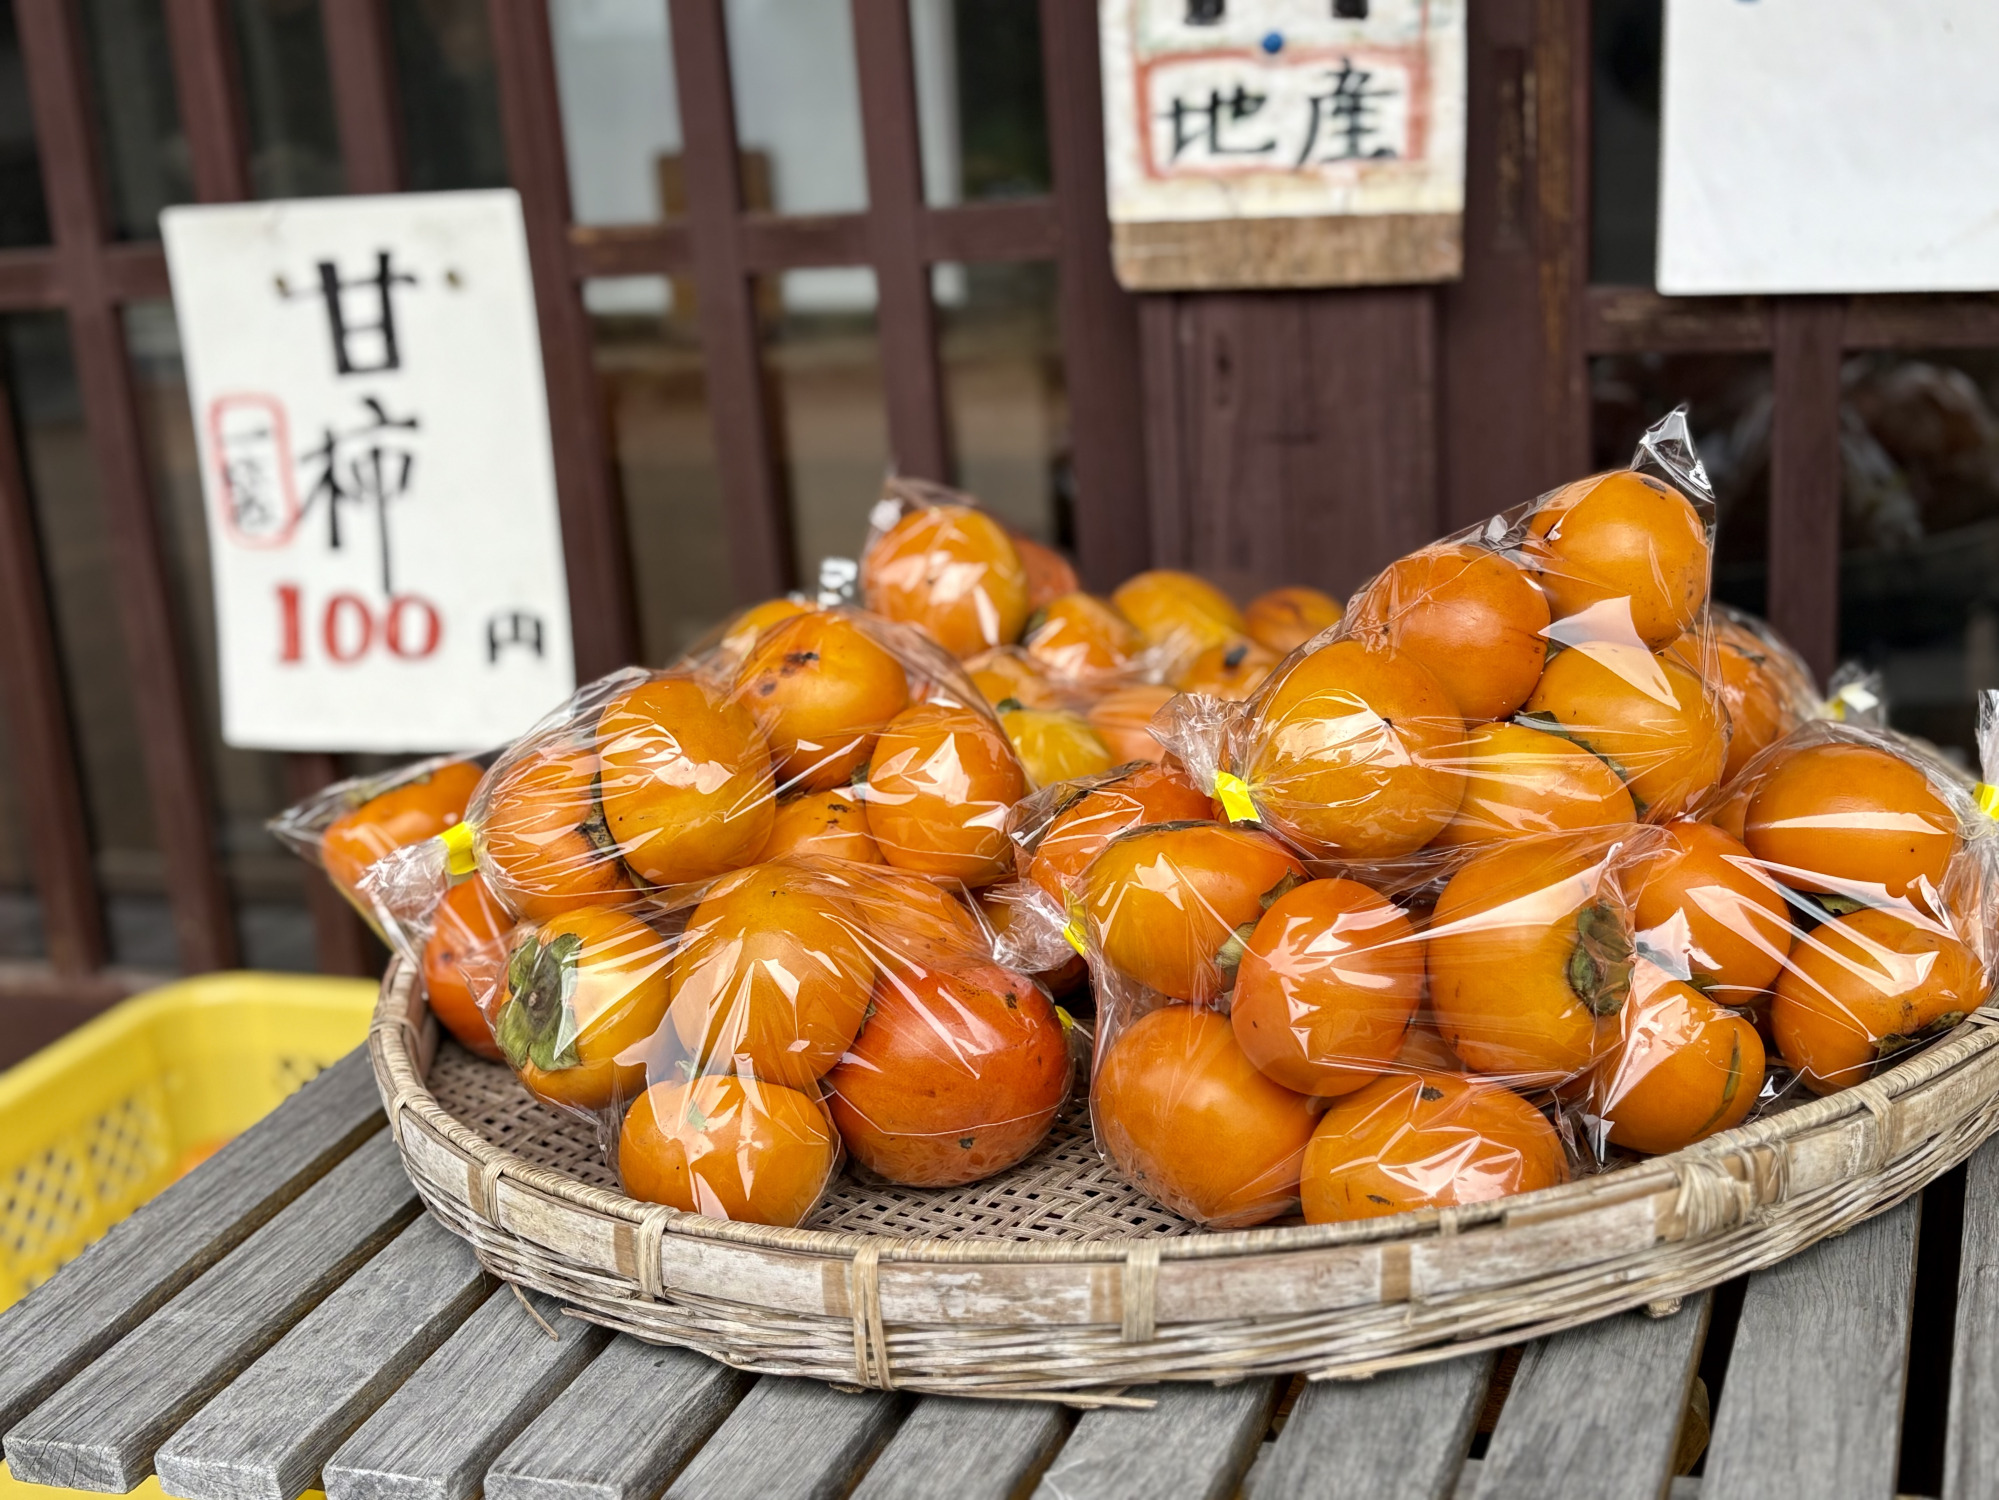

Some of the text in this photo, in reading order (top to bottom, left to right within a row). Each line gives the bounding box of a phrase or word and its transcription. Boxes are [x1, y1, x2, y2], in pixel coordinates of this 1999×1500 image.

[1154, 57, 1401, 168] 地産
[282, 251, 420, 596] 甘柿
[276, 582, 545, 666] 100 円
